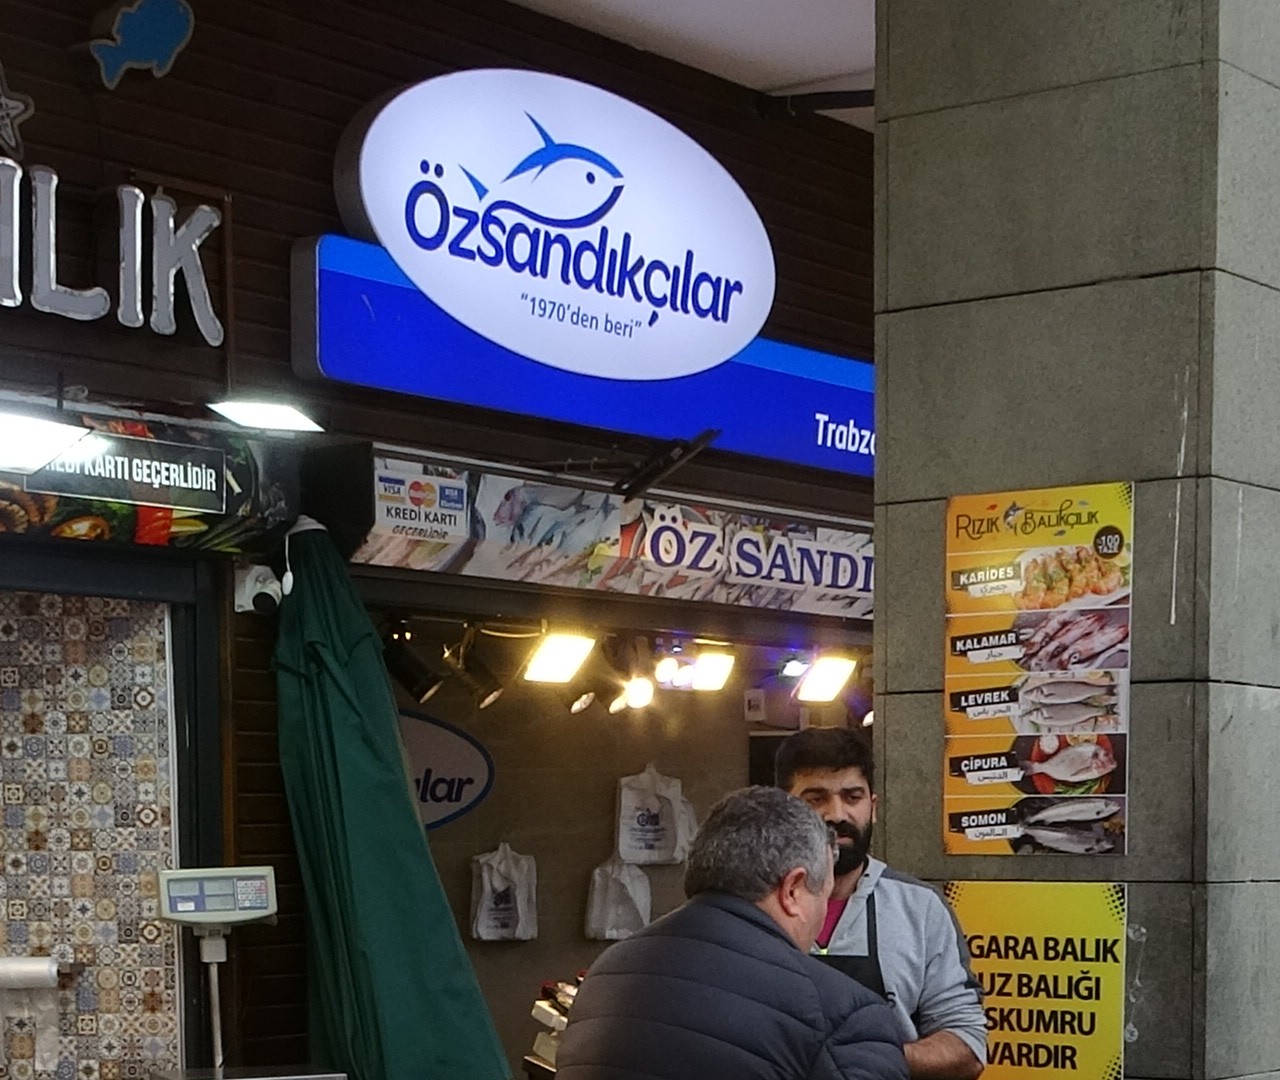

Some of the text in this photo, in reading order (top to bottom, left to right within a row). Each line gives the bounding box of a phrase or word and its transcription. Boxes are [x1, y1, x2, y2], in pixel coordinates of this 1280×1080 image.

[405, 160, 742, 327] Özsandıkçılar
[84, 456, 130, 480] KARTI
[132, 458, 216, 491] GEÇERLİDİR
[424, 511, 457, 527] KARTI
[955, 499, 1099, 541] RIZIK BALIKÇILIK
[649, 507, 720, 570] ÖZ
[959, 566, 1014, 585] KARİDES
[956, 632, 1016, 652] KALAMAR
[961, 690, 1009, 708] LEVREK
[961, 756, 1008, 773] ÇİPURA
[961, 812, 1007, 828] SOMON
[964, 934, 1120, 964] GARA BALIK
[974, 969, 1101, 1001] UZ BALIĞI
[984, 1006, 1096, 1036] SKUMRU
[985, 1041, 1078, 1070] VARDIR
